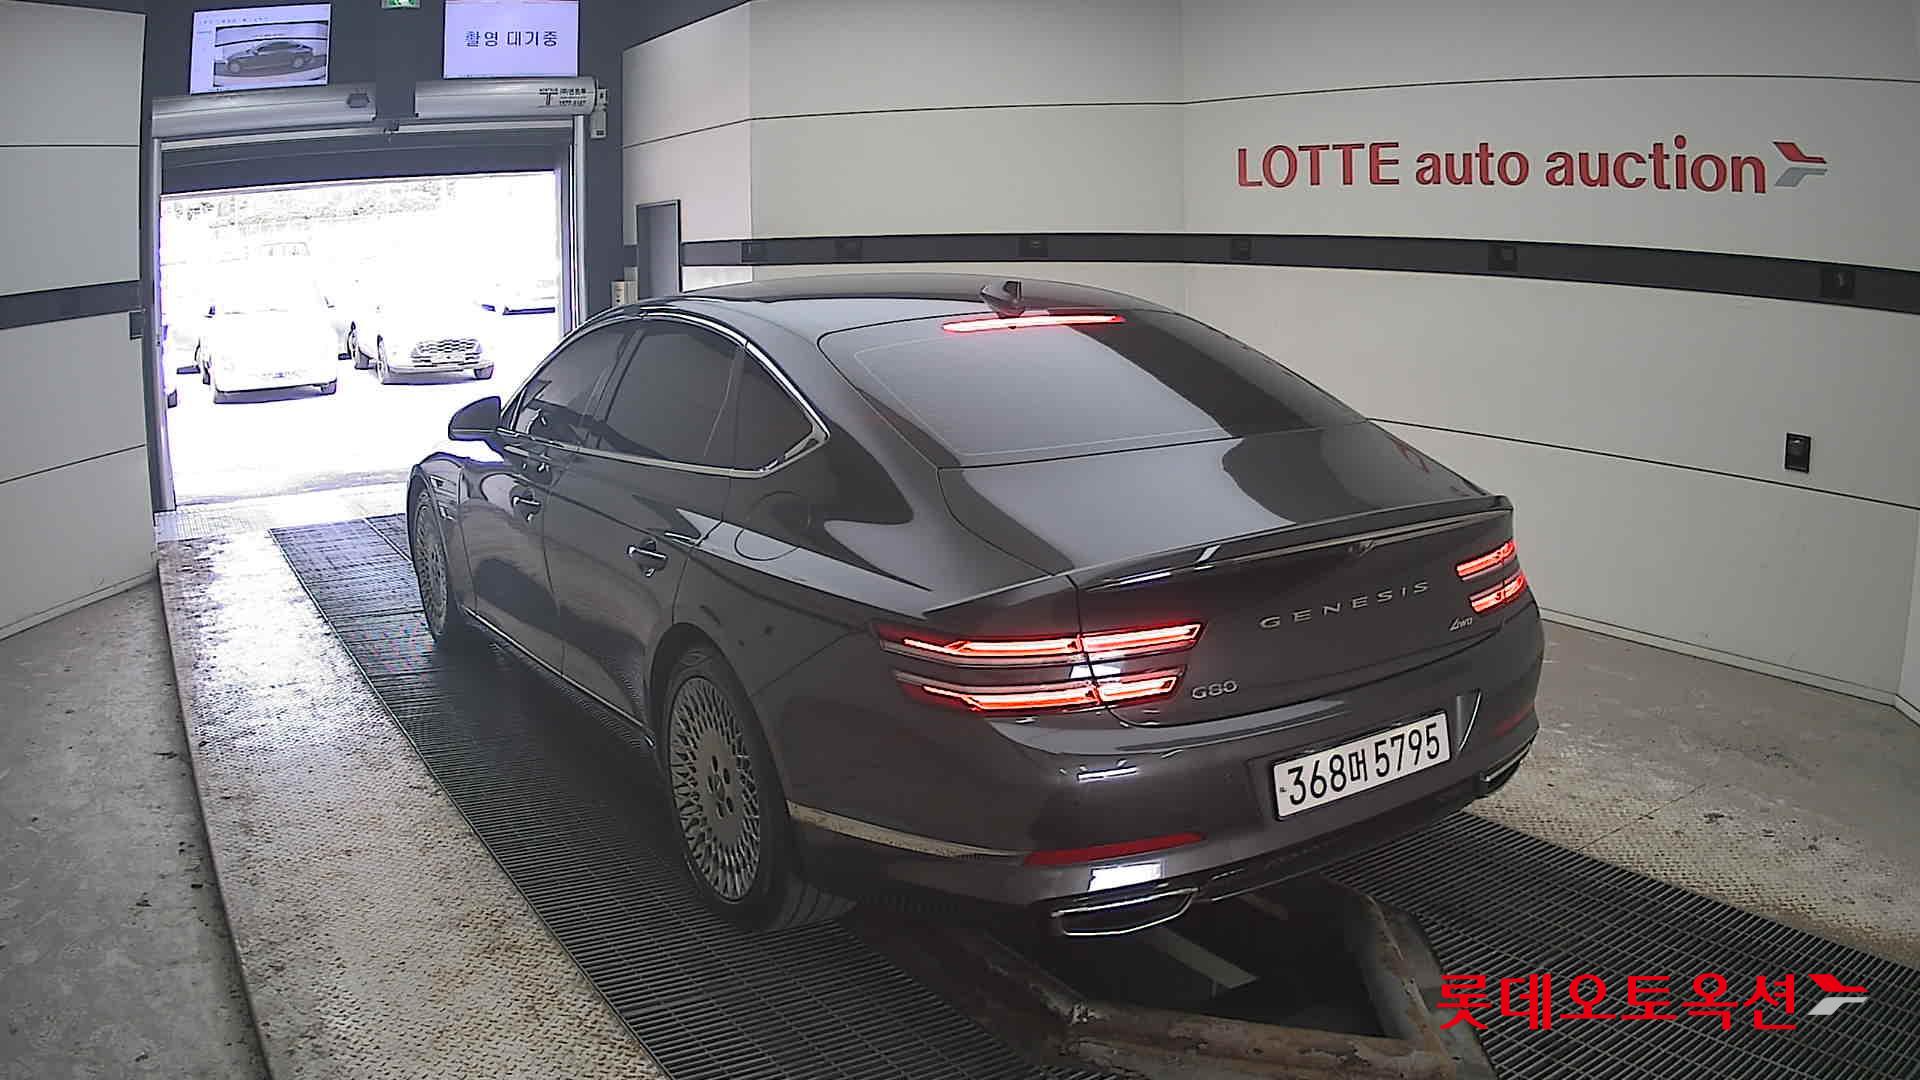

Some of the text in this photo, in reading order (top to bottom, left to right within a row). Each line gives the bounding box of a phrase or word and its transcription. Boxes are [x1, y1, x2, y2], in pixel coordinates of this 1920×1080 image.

[507, 31, 557, 47] 대기중
[1238, 134, 1767, 194] LOTTE auto auction
[1260, 581, 1430, 629] GENESIS
[1191, 680, 1238, 699] G80
[1374, 722, 1440, 778] 5795
